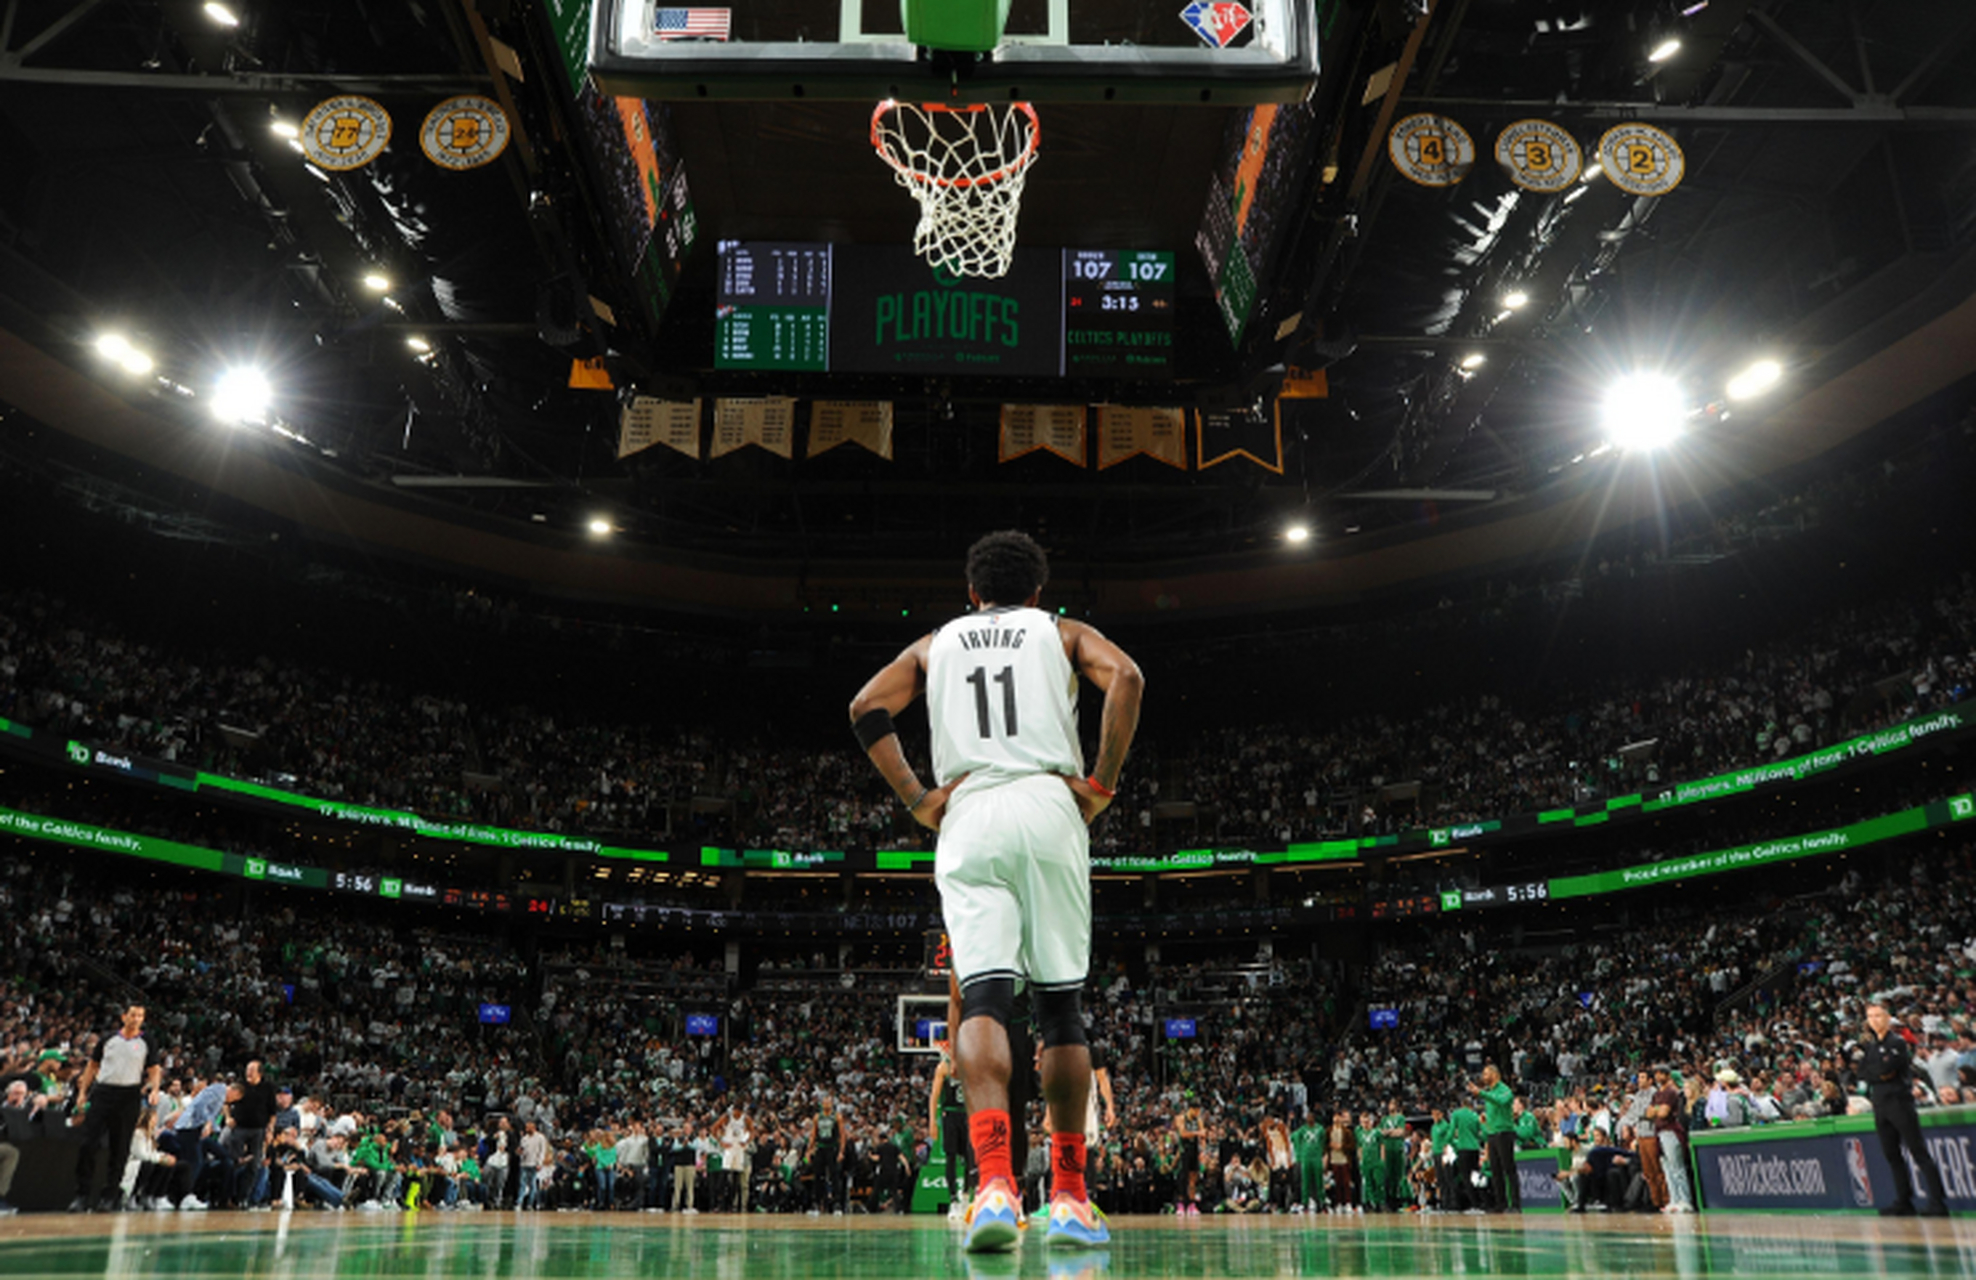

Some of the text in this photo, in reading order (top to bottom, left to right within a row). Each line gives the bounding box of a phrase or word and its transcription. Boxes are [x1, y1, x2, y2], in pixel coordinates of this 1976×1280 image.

[337, 126, 358, 139] 77
[1423, 140, 1440, 159] 4
[1530, 146, 1547, 165] 3
[1633, 150, 1650, 168] 2
[1072, 260, 1112, 279] 107
[1128, 262, 1168, 280] 107
[1101, 294, 1140, 312] 3:15
[876, 289, 1019, 347] PLAYOFFS
[1067, 328, 1172, 347] CELTICS PLAYOFFS
[958, 628, 1027, 651] IRVING
[966, 665, 1018, 739] 11
[95, 751, 133, 771] Bank
[1659, 790, 1672, 803] 17
[1856, 732, 1908, 755] Celtics
[1952, 798, 1973, 816] TD
[15, 816, 39, 831] the
[42, 821, 93, 841] Celtics
[1753, 841, 1802, 859] Celtics
[247, 859, 265, 875] TD
[335, 873, 373, 892] 5:56
[383, 880, 400, 894] TD
[1444, 894, 1460, 908] TD
[1506, 883, 1547, 902] 5:56
[886, 913, 918, 929] 107
[1718, 1153, 1827, 1196] NBATickets.com
